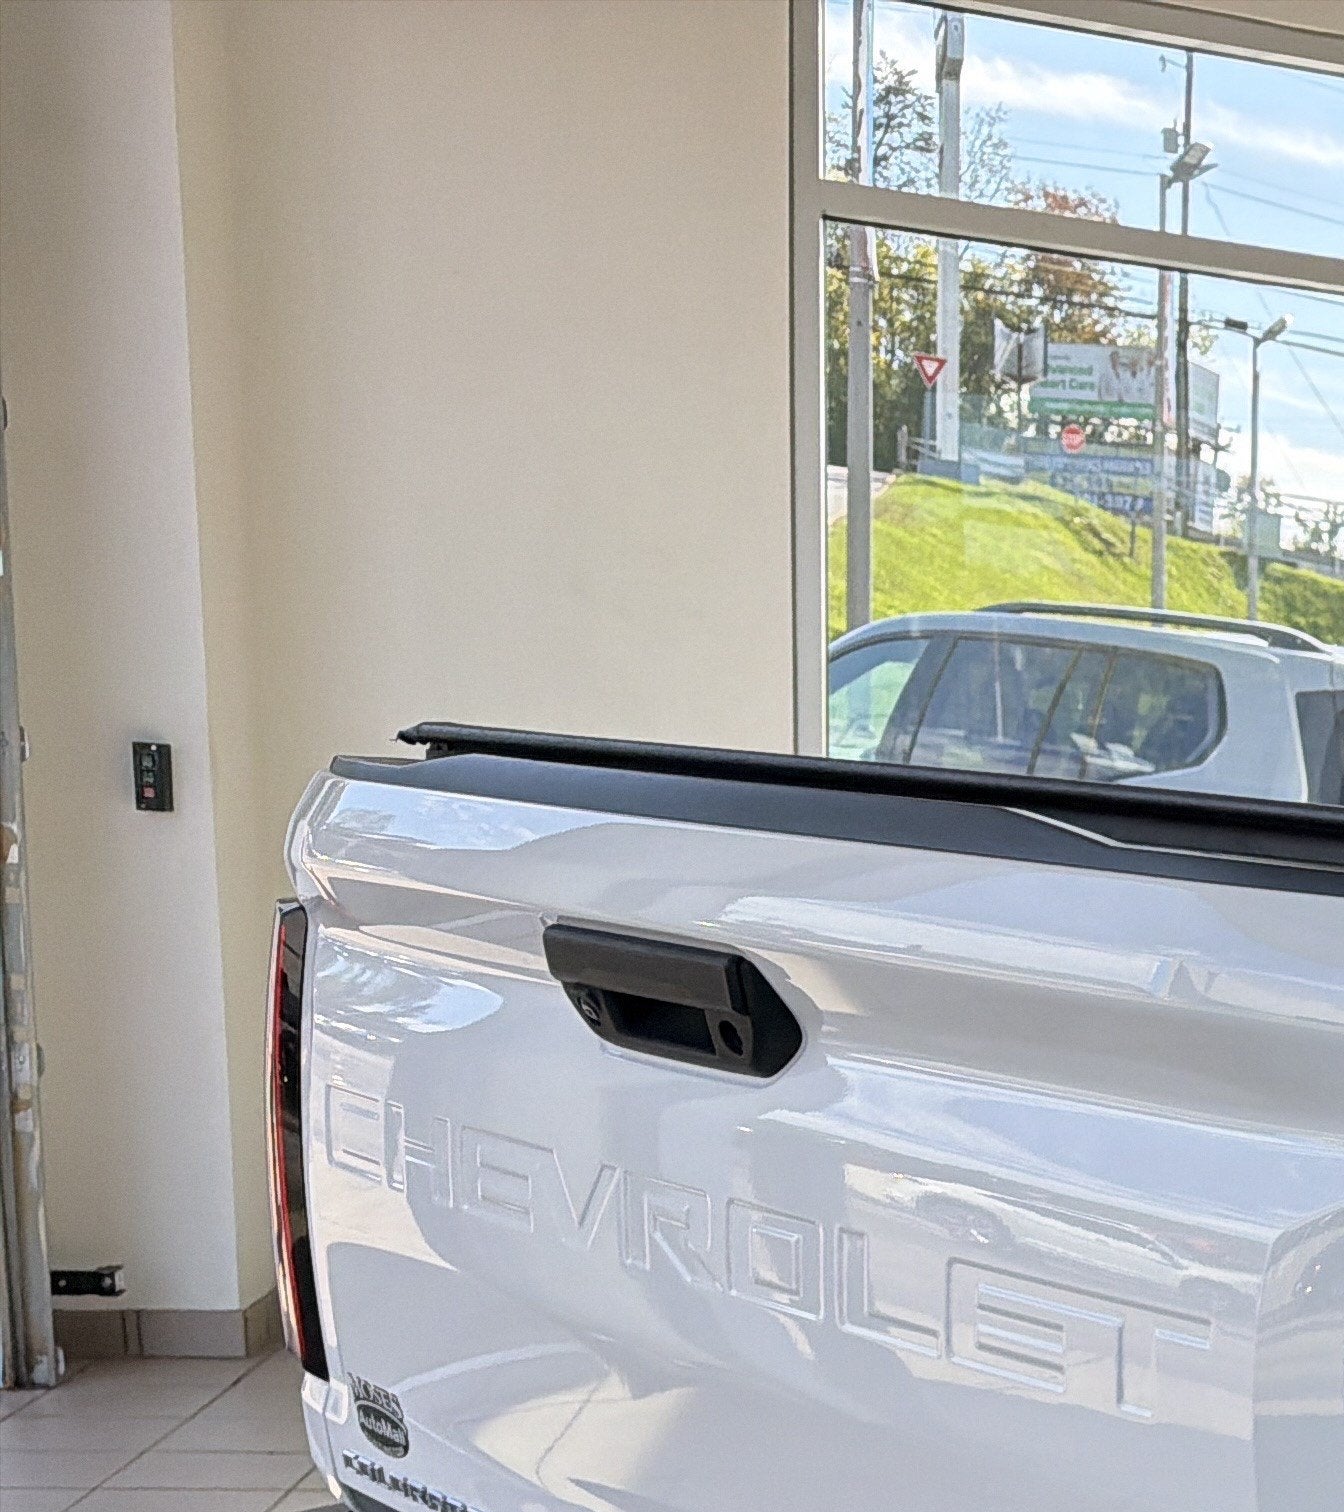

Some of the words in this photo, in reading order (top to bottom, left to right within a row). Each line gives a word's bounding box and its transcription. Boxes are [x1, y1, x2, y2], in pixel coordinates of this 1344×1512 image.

[325, 1083, 1213, 1418] CHEVROLET
[348, 1372, 405, 1422] MOSES
[358, 1408, 407, 1446] AutoMall
